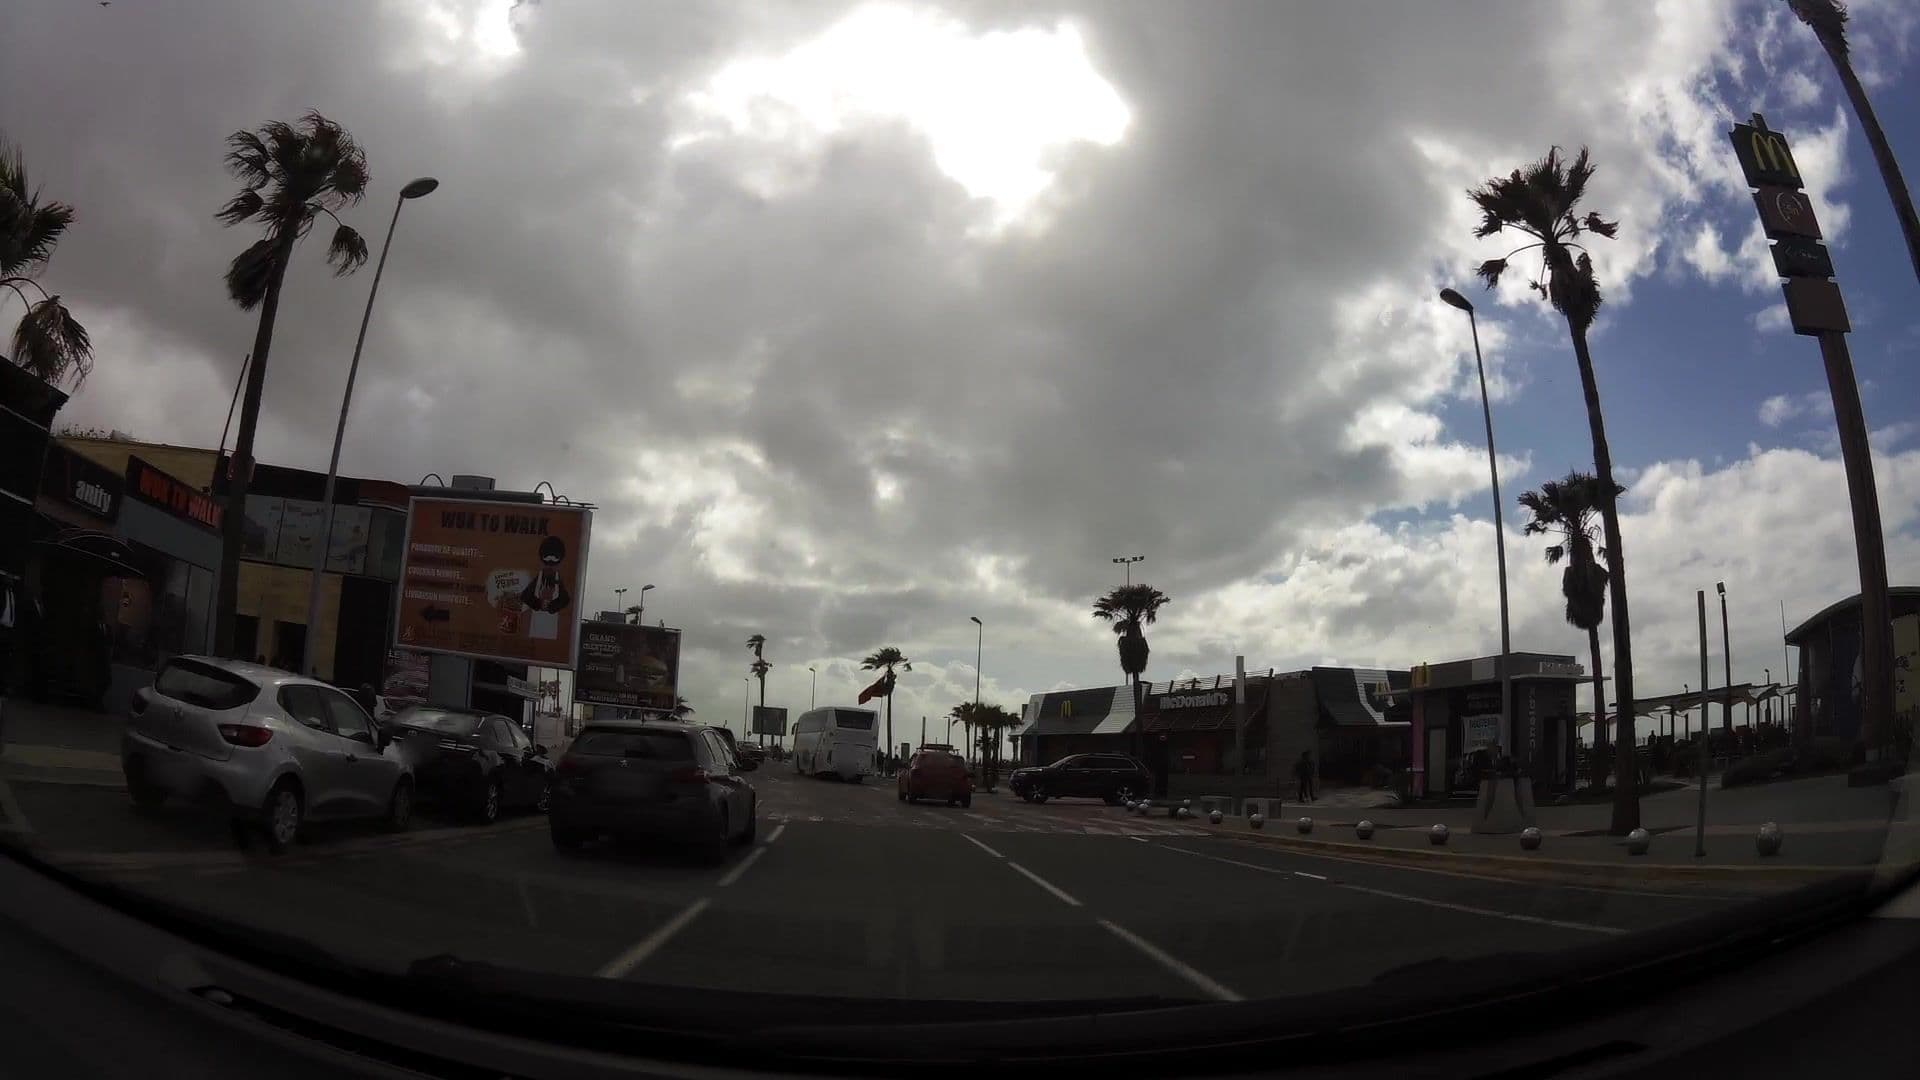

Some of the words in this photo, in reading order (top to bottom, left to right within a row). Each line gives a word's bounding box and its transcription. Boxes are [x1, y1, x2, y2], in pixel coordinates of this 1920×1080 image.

[74, 480, 111, 513] anity
[479, 513, 500, 532] TO
[503, 513, 550, 536] WALK
